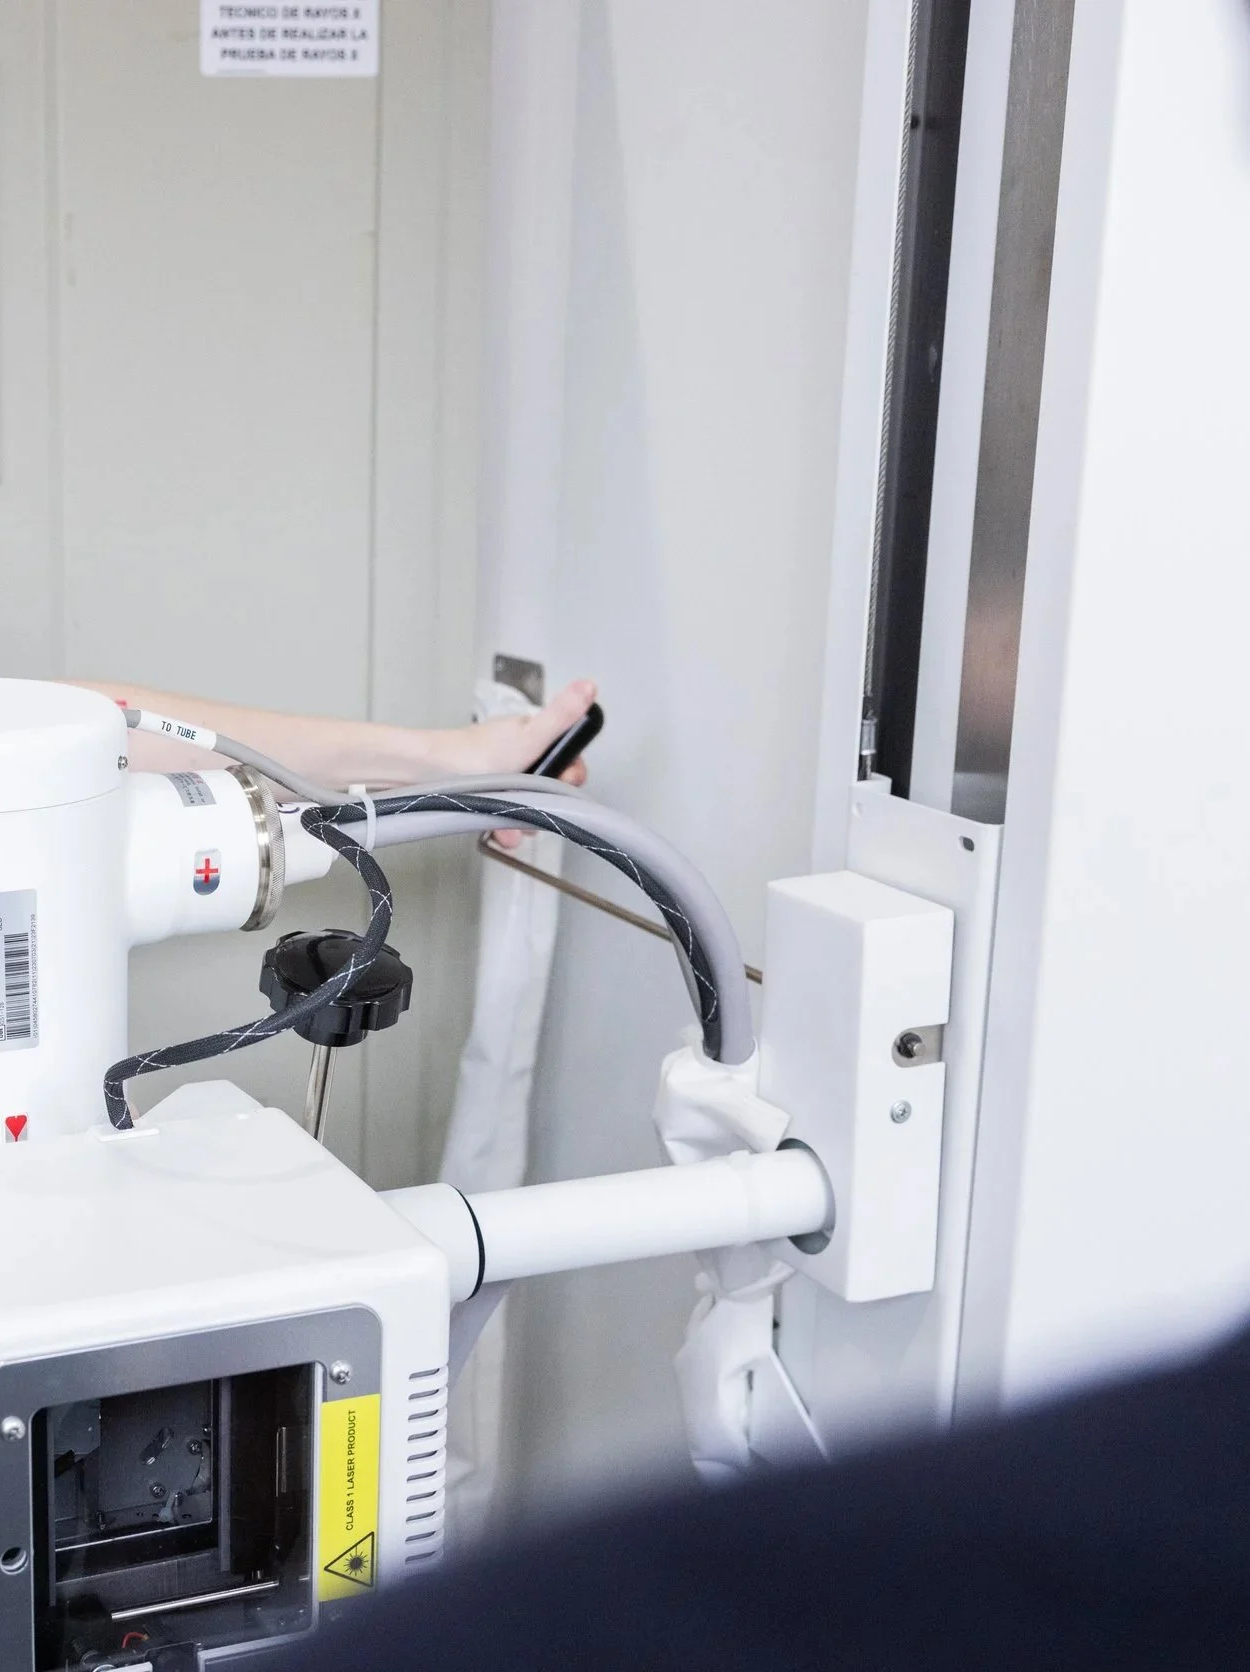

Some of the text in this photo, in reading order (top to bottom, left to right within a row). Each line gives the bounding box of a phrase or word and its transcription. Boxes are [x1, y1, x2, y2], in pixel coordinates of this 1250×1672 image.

[282, 6, 299, 19] DE
[304, 6, 348, 19] RAYOS
[212, 27, 368, 40] ANTES DE REALIZAR LA
[220, 49, 276, 61] PRUEBA
[279, 49, 298, 61] DE
[302, 49, 347, 61] RAYOS
[161, 720, 197, 740] TO TUBE
[347, 1409, 357, 1457] PRODUCT
[346, 1458, 355, 1490] LASER
[346, 1499, 355, 1531] CLASS
